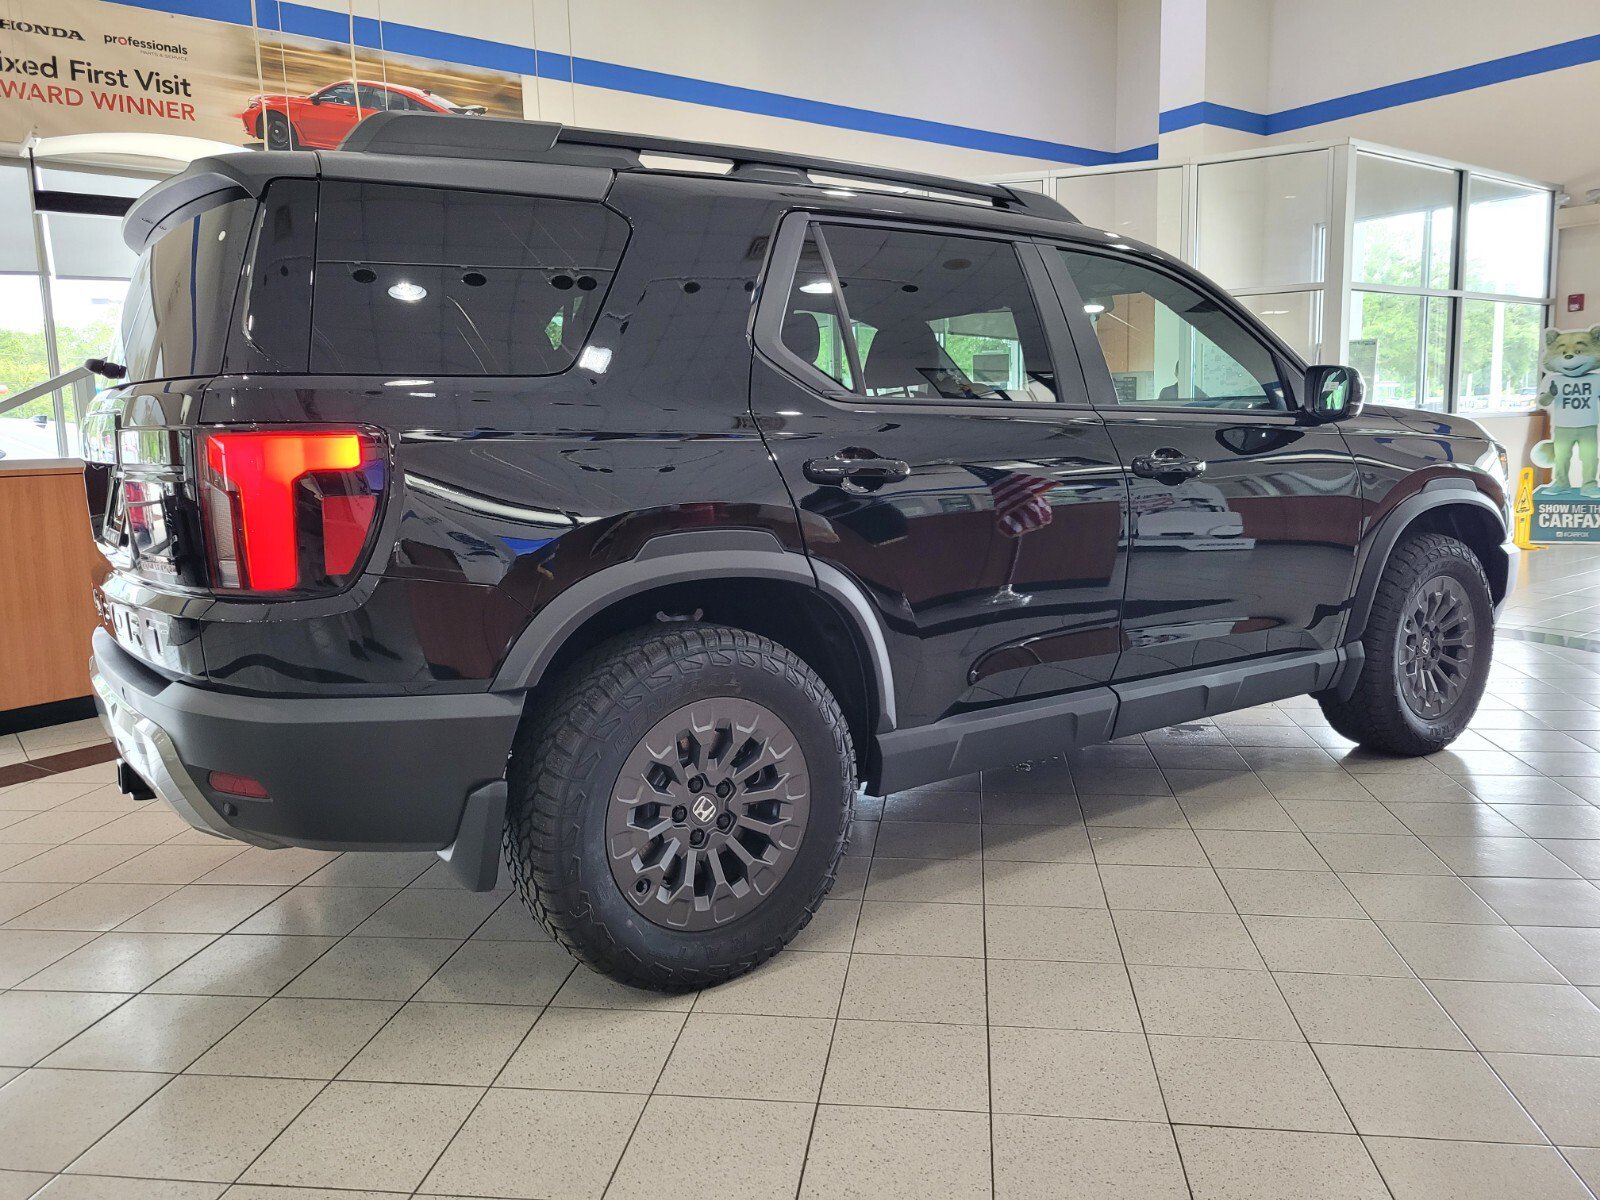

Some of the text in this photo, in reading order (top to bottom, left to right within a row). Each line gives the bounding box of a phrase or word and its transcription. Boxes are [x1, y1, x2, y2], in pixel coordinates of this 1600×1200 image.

[0, 18, 86, 41] HONDA
[103, 34, 188, 55] professionals
[69, 59, 129, 89] First
[133, 68, 192, 97] Visit
[0, 78, 196, 121] WARD WINNER
[1562, 382, 1592, 396] CAR
[1562, 397, 1591, 410] FOX
[1538, 503, 1570, 514] SHOW
[1571, 504, 1587, 514] ME
